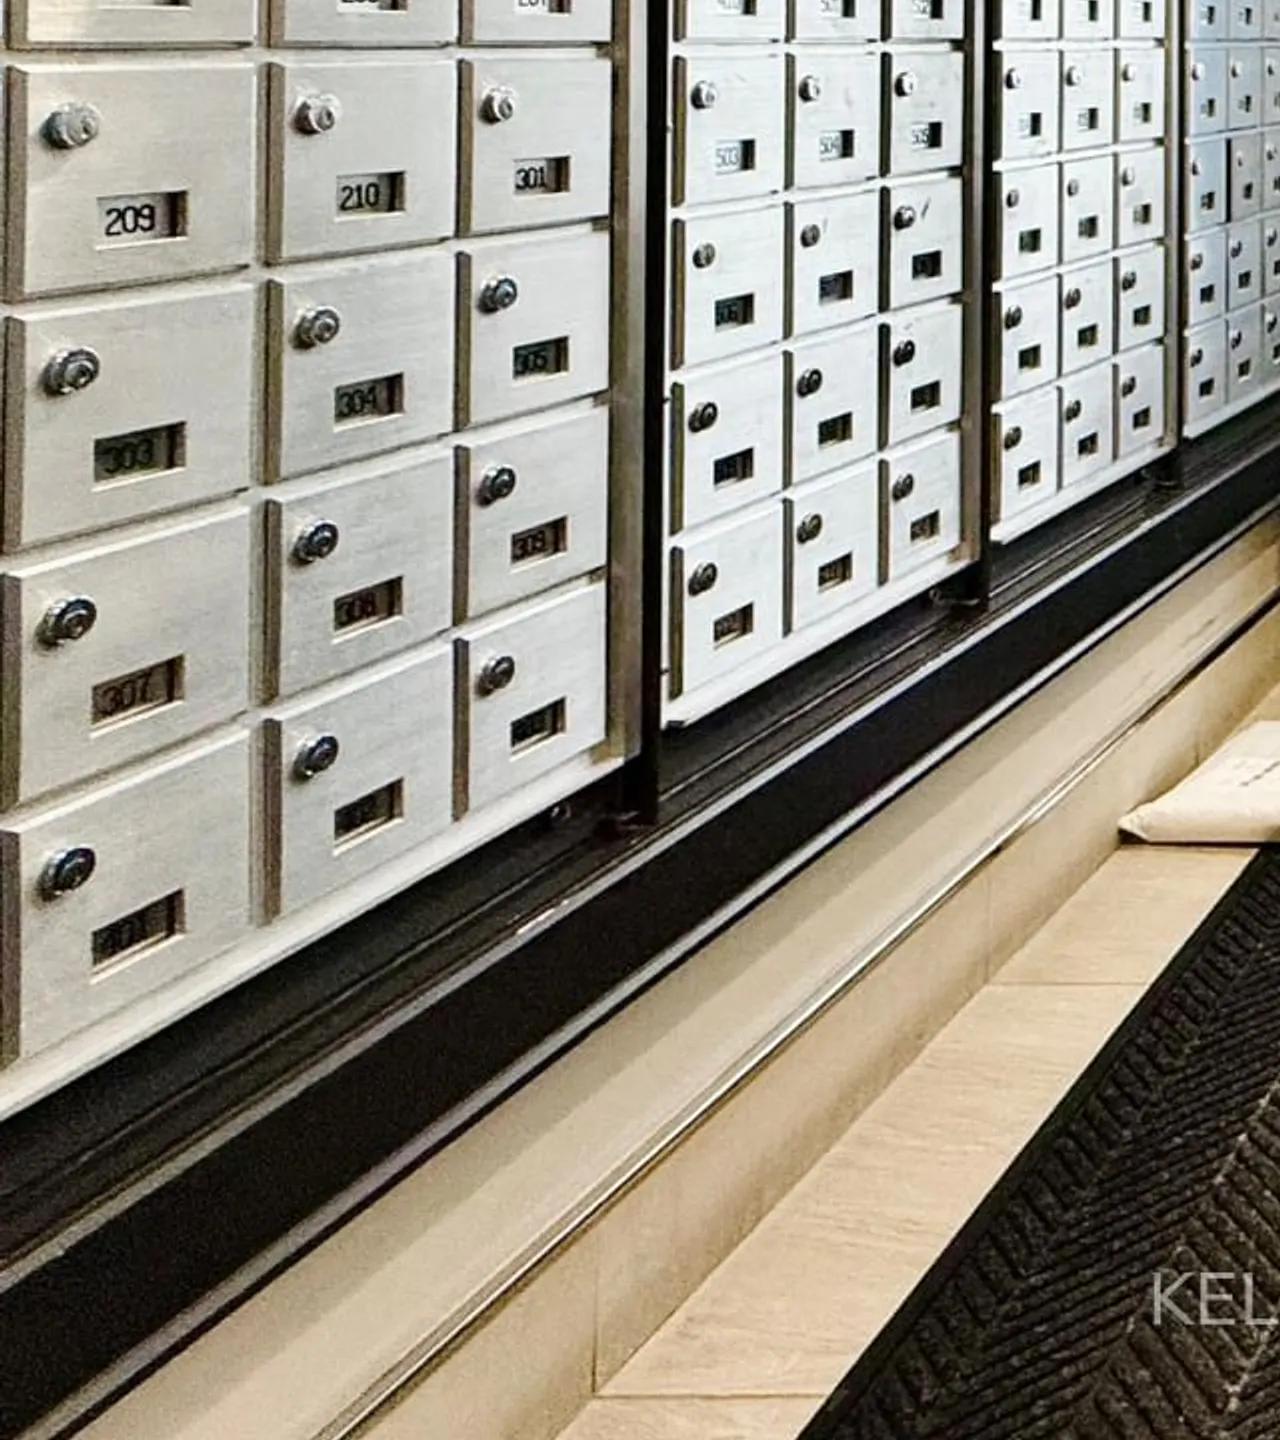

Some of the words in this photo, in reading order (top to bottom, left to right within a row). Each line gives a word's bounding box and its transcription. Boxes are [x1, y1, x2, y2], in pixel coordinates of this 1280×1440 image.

[515, 165, 545, 190] 301
[339, 182, 380, 211] 210
[105, 203, 156, 237] 209
[337, 385, 378, 416] 304
[104, 438, 155, 474] 303
[101, 671, 152, 716] 307
